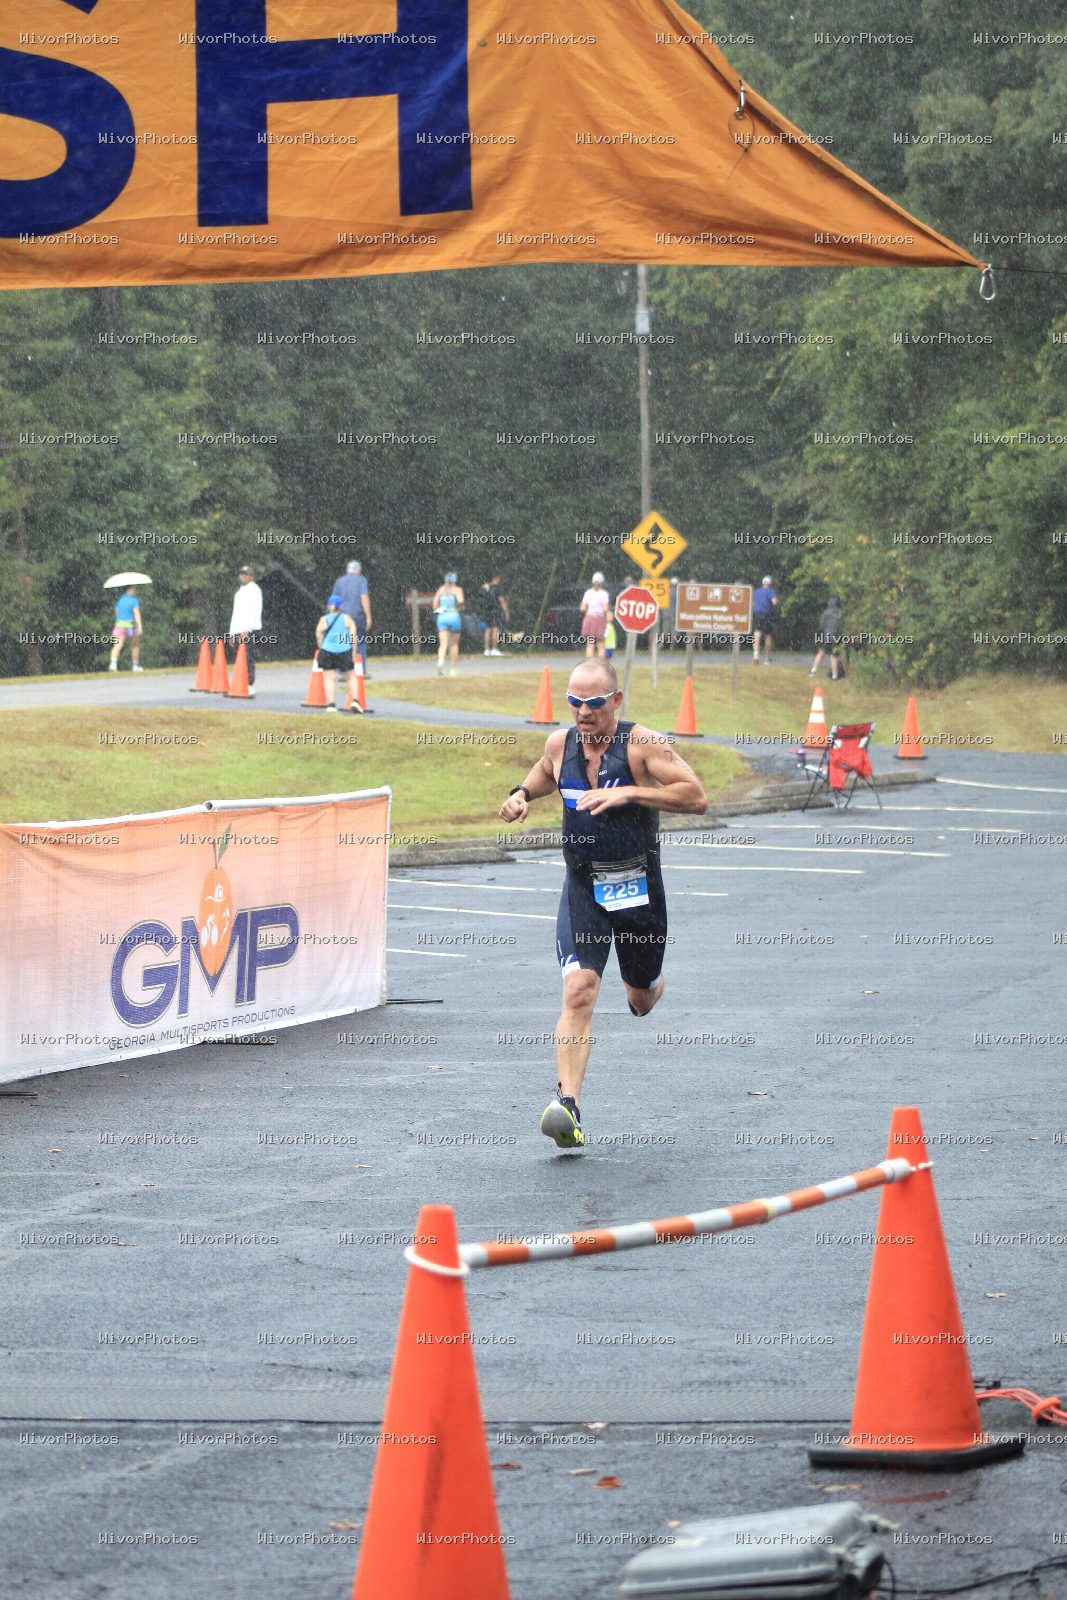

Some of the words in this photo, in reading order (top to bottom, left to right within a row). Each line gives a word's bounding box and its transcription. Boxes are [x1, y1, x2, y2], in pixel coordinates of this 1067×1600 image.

[618, 599, 655, 620] STOP
[603, 880, 639, 901] 225
[110, 902, 299, 1030] GMP
[108, 1032, 156, 1051] GEORGIA
[161, 1018, 229, 1041] MULTISPORTS
[231, 1005, 297, 1027] PRODUCTIONS
